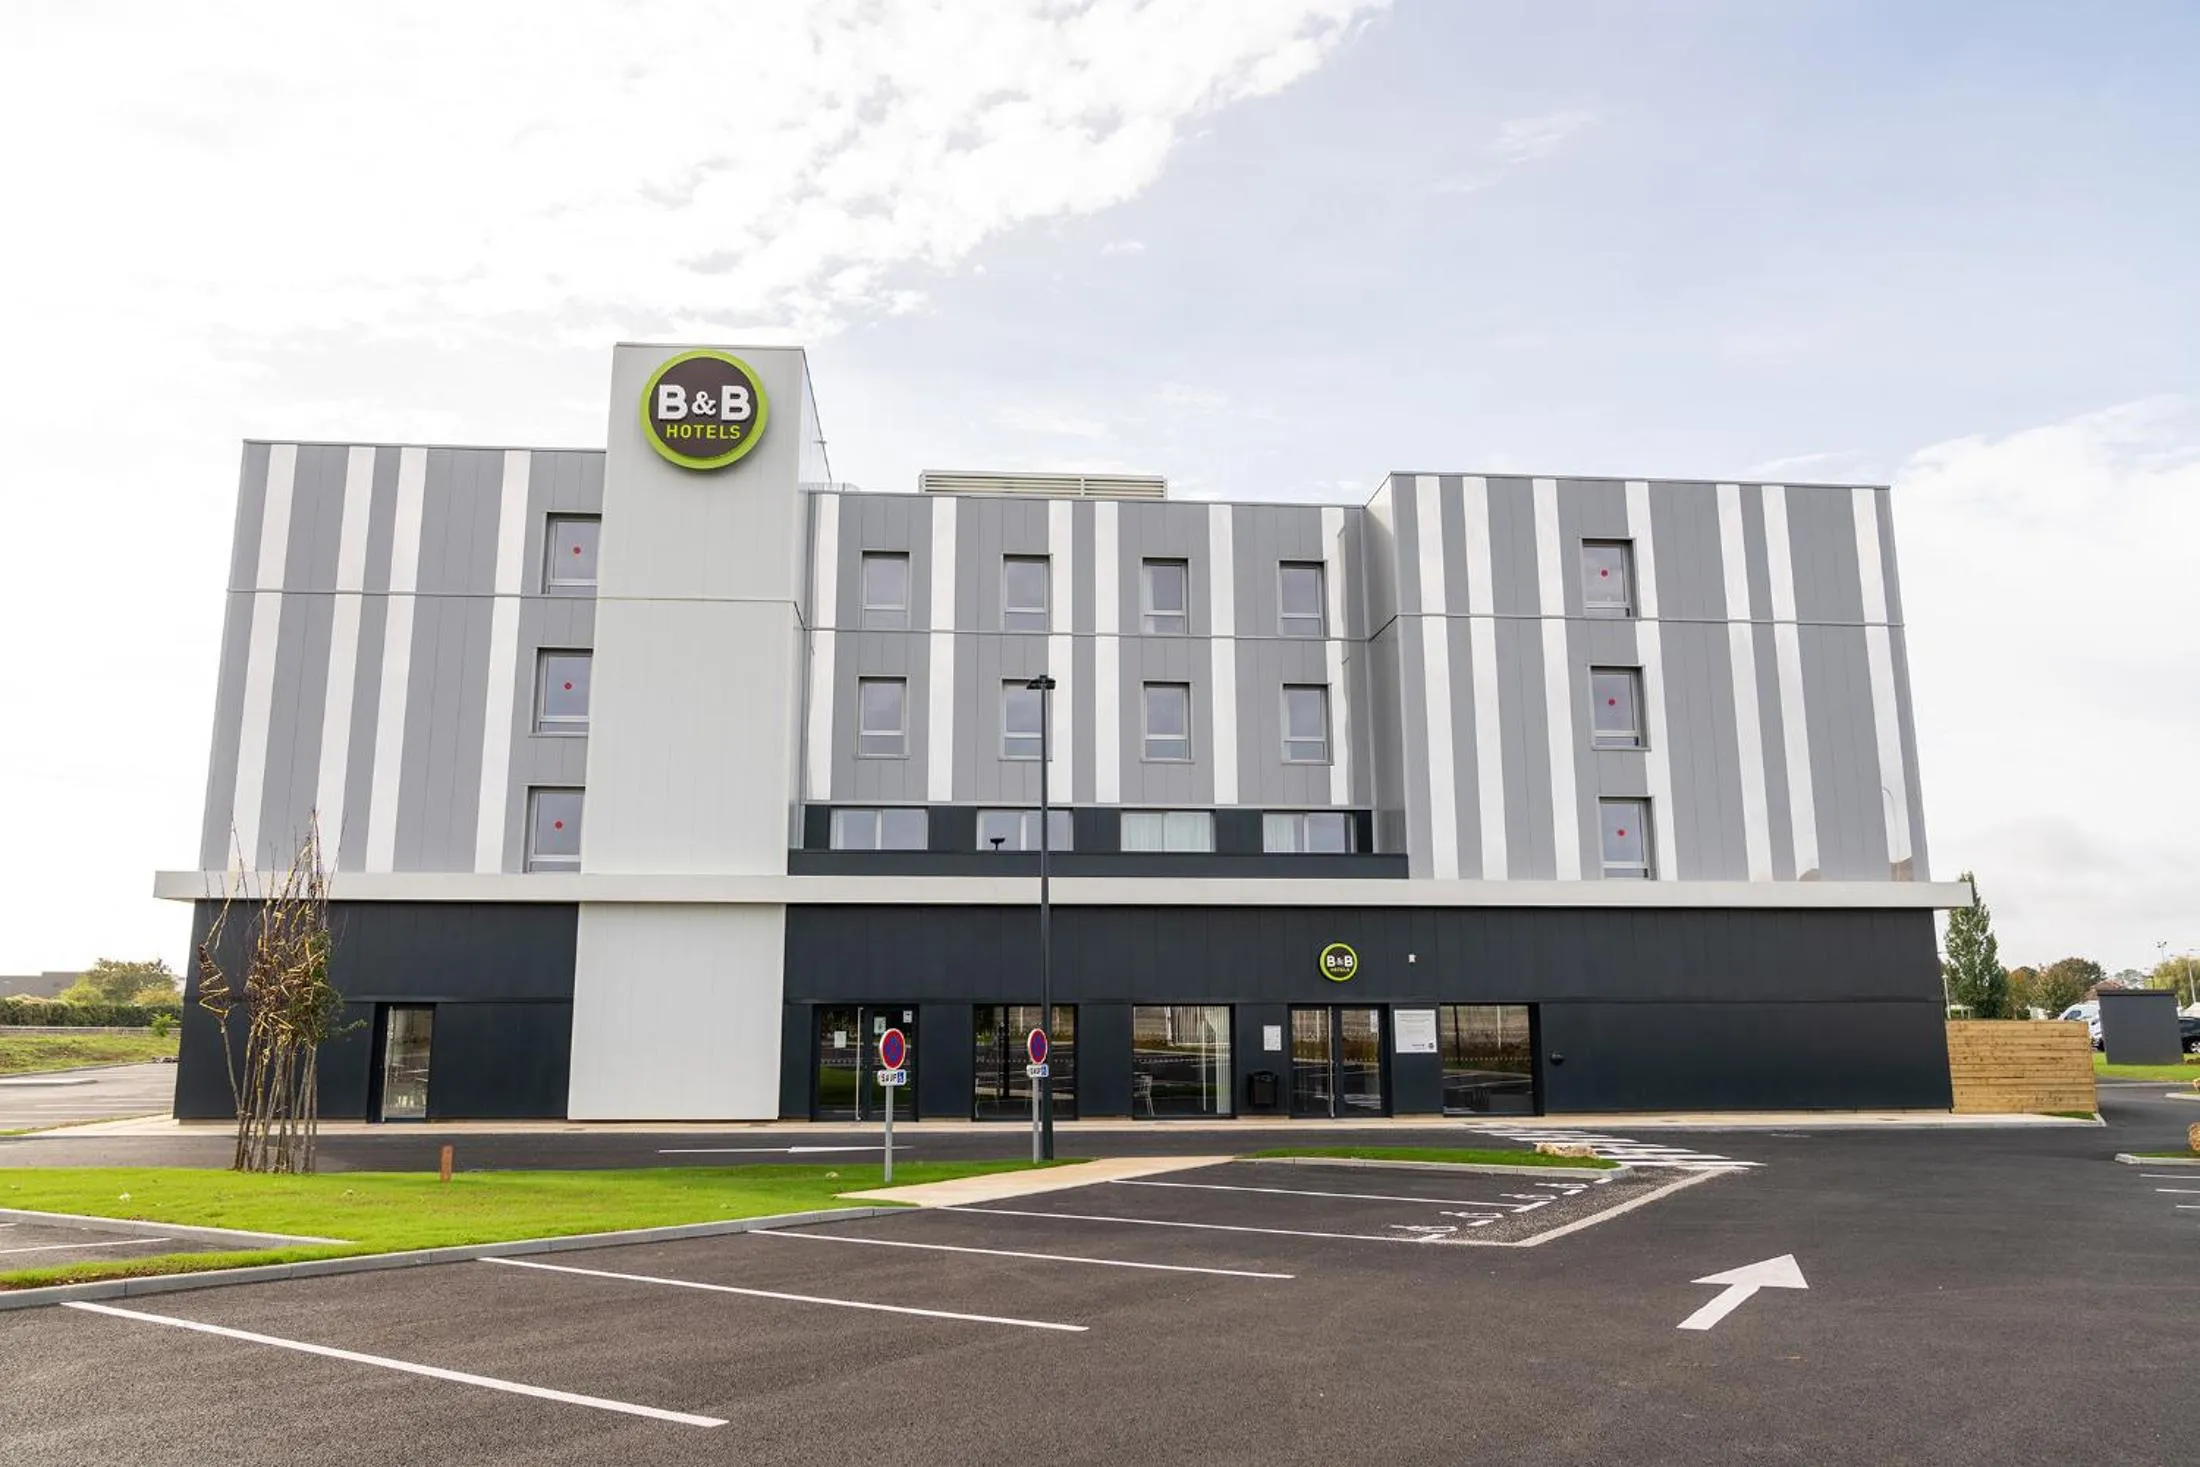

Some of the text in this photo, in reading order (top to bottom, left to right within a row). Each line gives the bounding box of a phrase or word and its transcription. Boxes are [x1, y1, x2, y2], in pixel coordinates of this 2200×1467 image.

[658, 384, 751, 420] B&B
[666, 424, 741, 439] HOTELS
[1327, 955, 1353, 967] B&B
